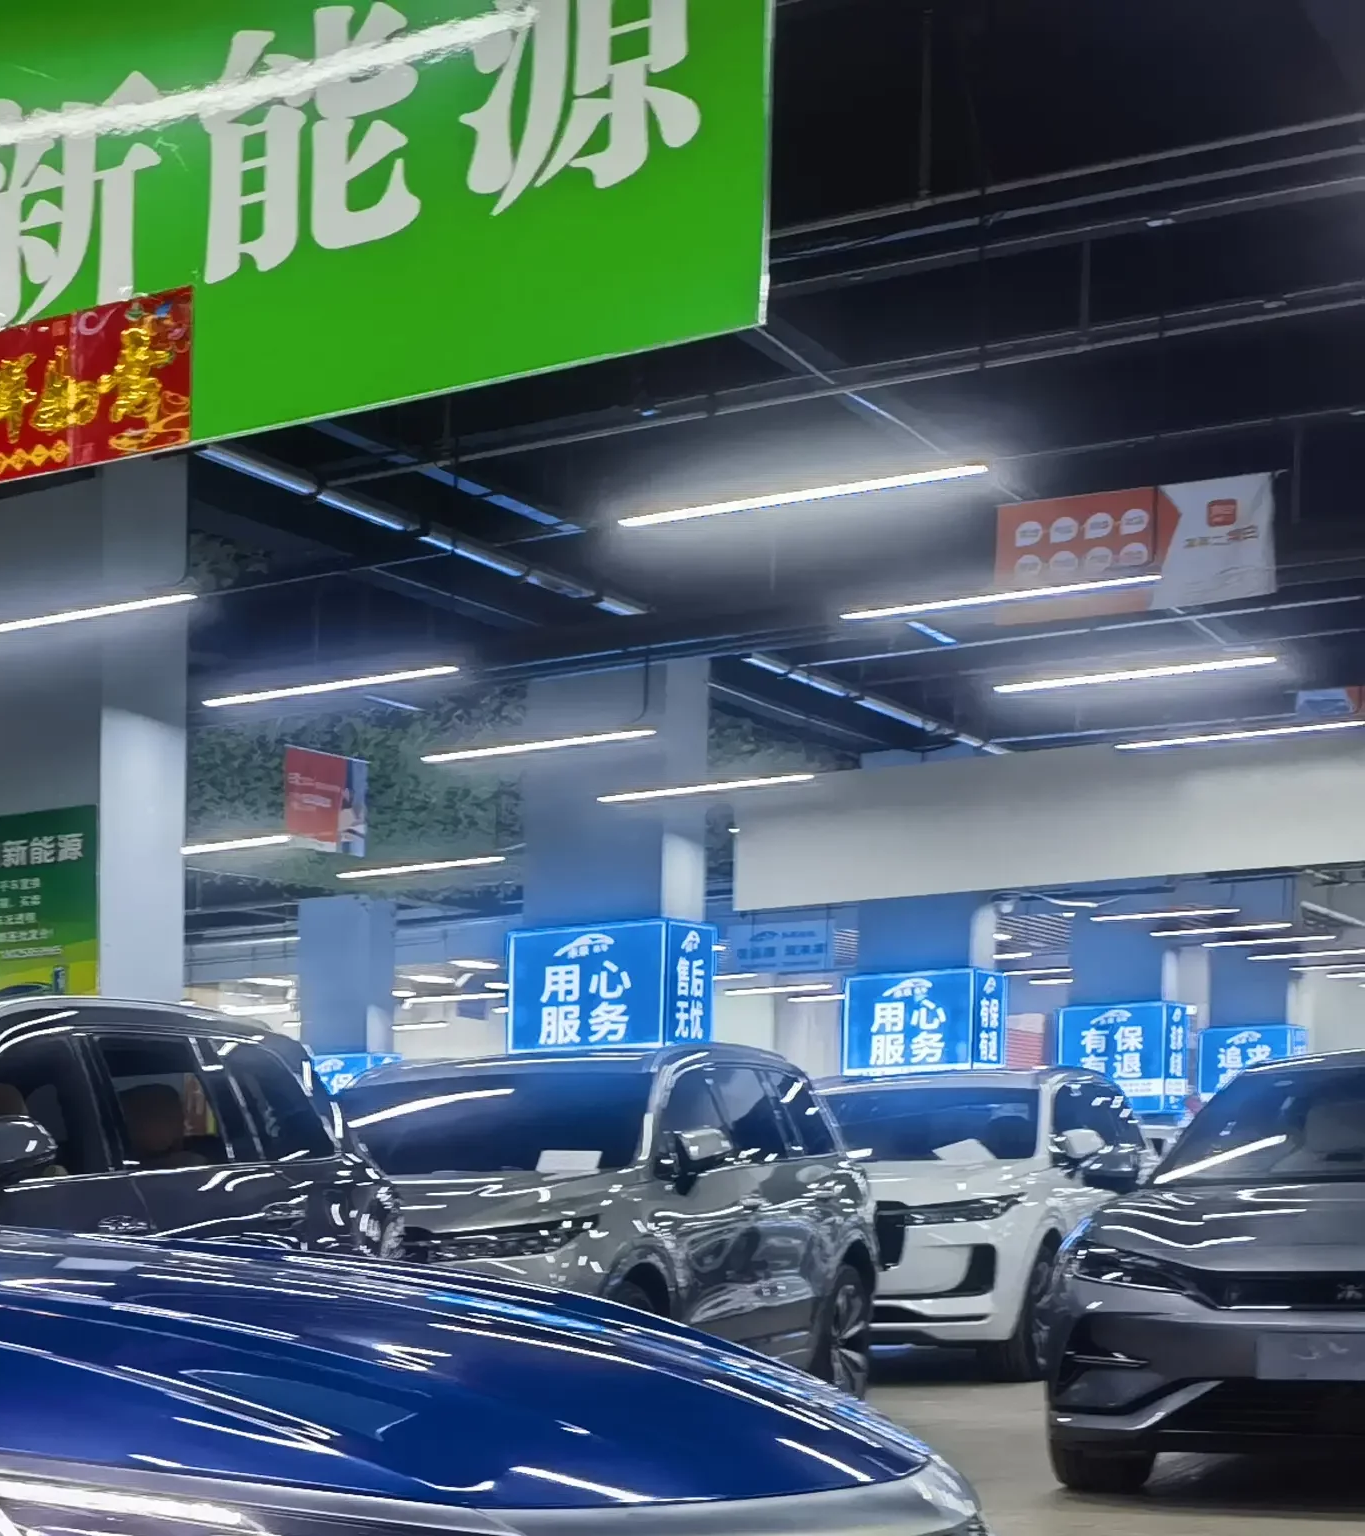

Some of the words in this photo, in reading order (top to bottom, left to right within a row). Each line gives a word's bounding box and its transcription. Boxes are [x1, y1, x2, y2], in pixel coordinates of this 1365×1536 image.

[540, 959, 633, 1004] 用心
[538, 1001, 630, 1046] 服务
[870, 999, 947, 1034] 用心
[869, 1030, 946, 1066] 服务
[1080, 1025, 1144, 1054] 有保
